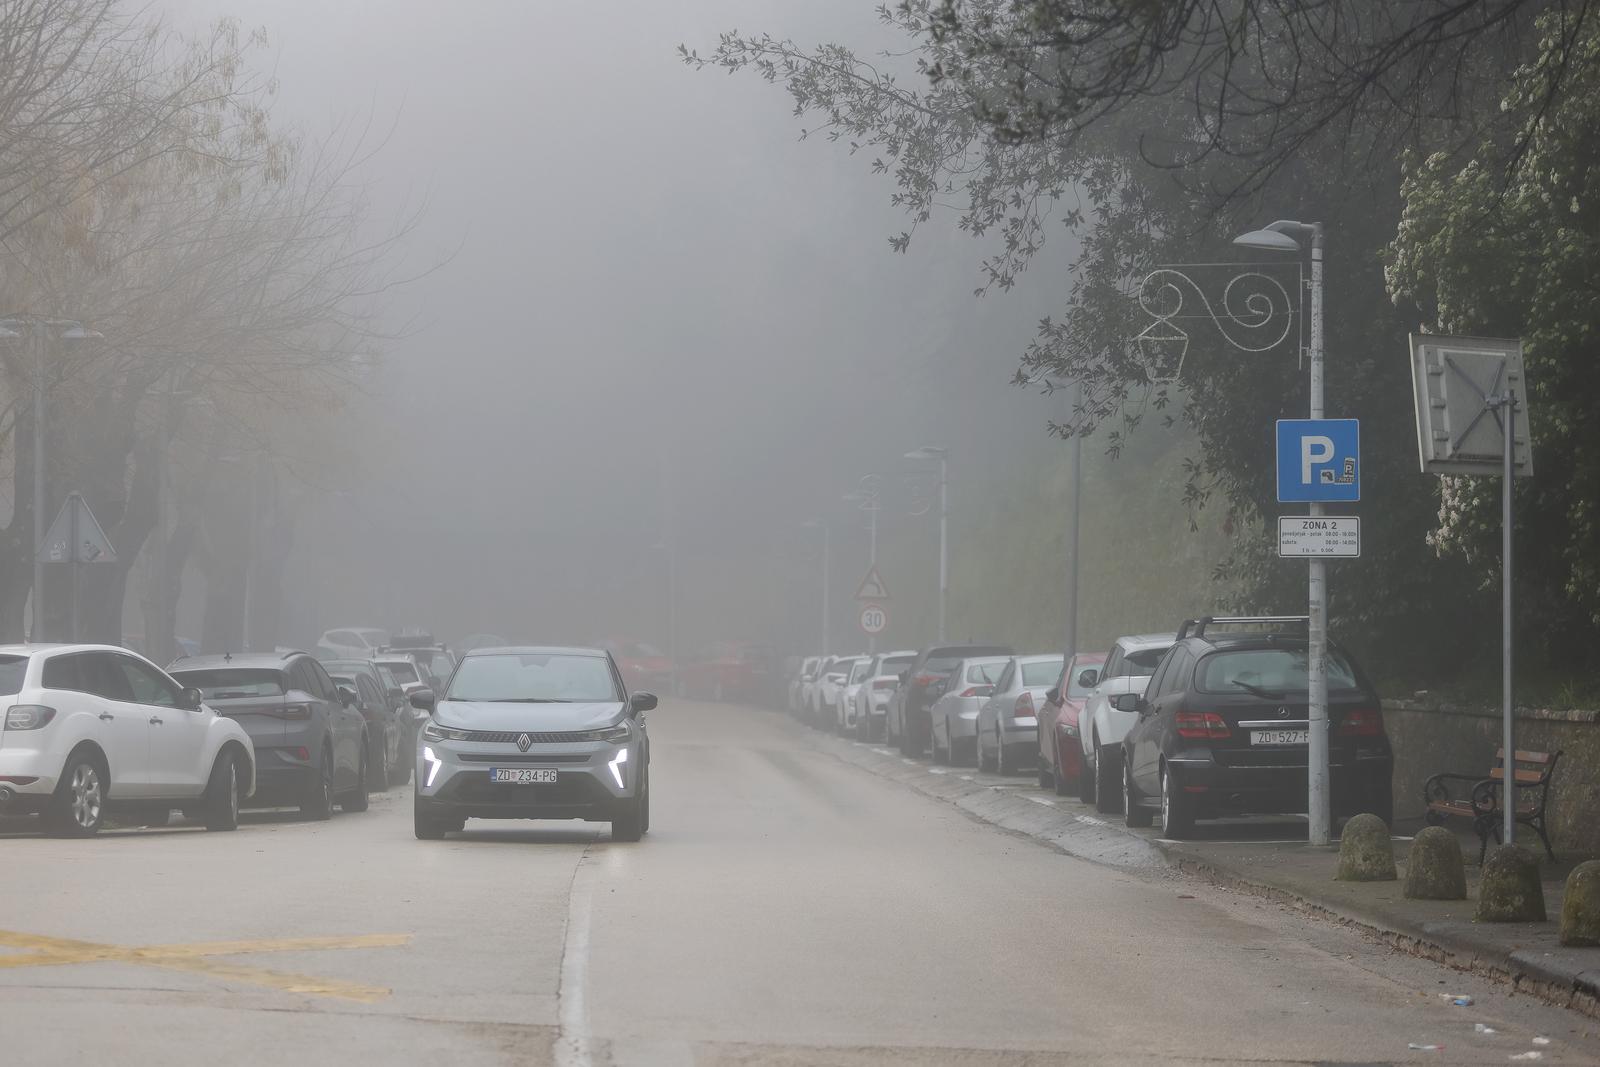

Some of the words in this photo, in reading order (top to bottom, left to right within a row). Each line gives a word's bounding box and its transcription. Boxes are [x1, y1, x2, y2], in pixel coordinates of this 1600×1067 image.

[1301, 435, 1335, 484] P
[1302, 521, 1327, 530] ZONA
[1331, 521, 1337, 529] 2
[865, 612, 882, 628] 30
[1258, 731, 1271, 743] ZD
[498, 770, 510, 780] ZD
[518, 770, 556, 781] 234-PG
